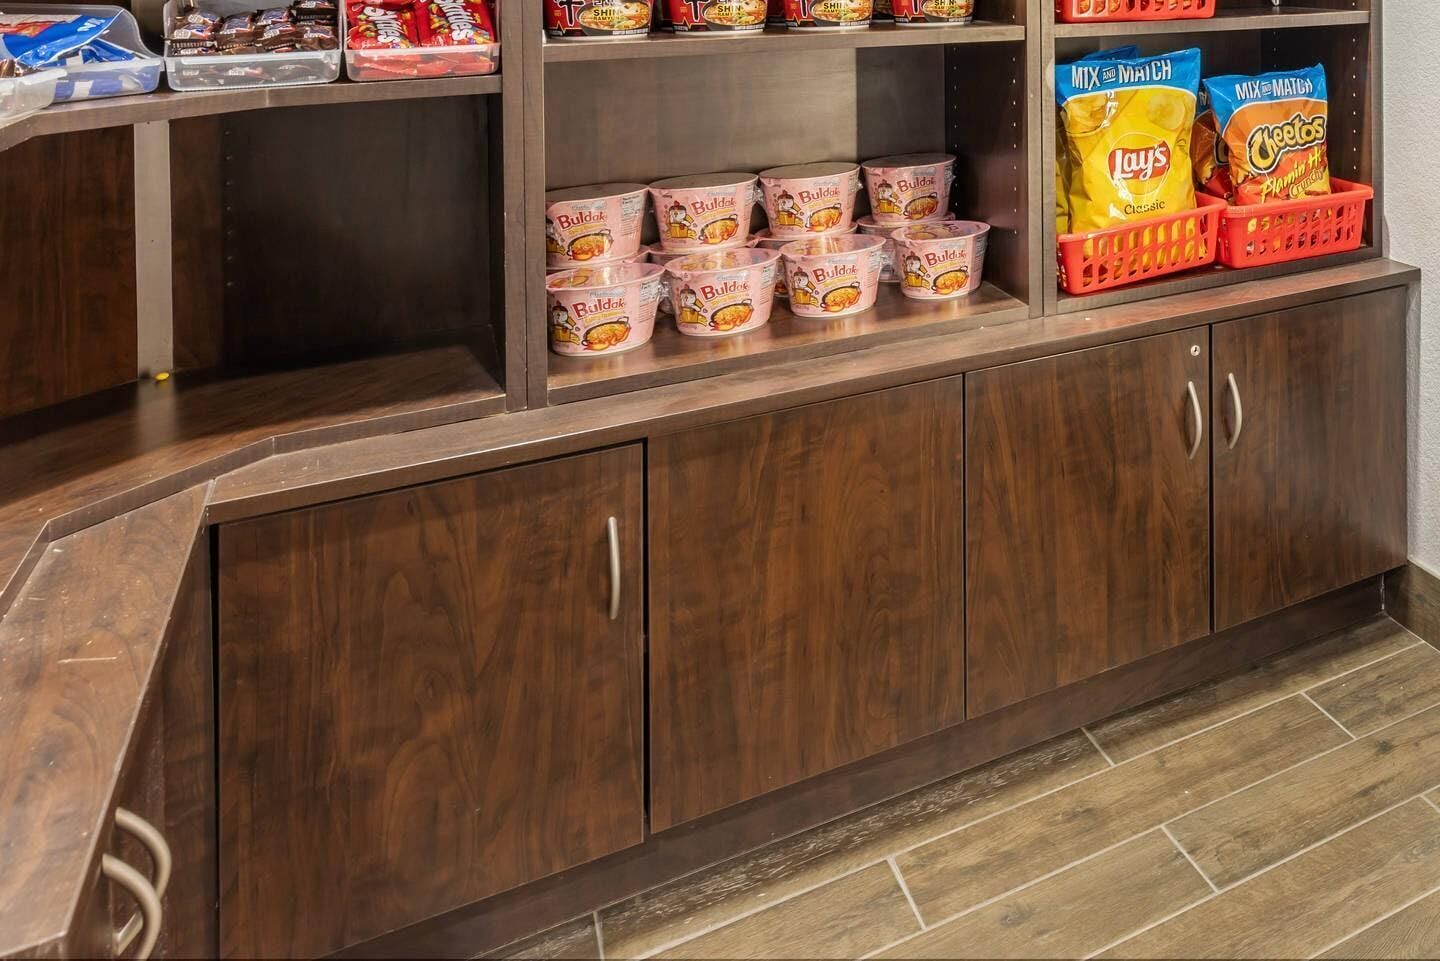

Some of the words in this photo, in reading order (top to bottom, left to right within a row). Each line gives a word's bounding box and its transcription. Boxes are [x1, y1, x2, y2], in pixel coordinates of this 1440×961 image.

[363, 7, 404, 43] Skittles
[1071, 65, 1100, 90] MIX
[1102, 68, 1116, 80] AND
[1119, 60, 1172, 83] MATCH
[1235, 81, 1261, 100] MIX
[1272, 77, 1313, 97] MATCH
[1248, 112, 1326, 173] Cheetos
[1113, 144, 1168, 180] Lay's
[897, 177, 935, 192] Buldak
[1289, 170, 1323, 198] Crunchy
[798, 188, 839, 203] Buldak
[692, 197, 735, 215] Buldak
[1124, 200, 1165, 215] Classic
[558, 210, 605, 230] Buldak
[925, 250, 966, 266] Buldak
[813, 265, 856, 283] Buldak
[701, 281, 748, 300] Buldak
[573, 298, 624, 319] Buldak
